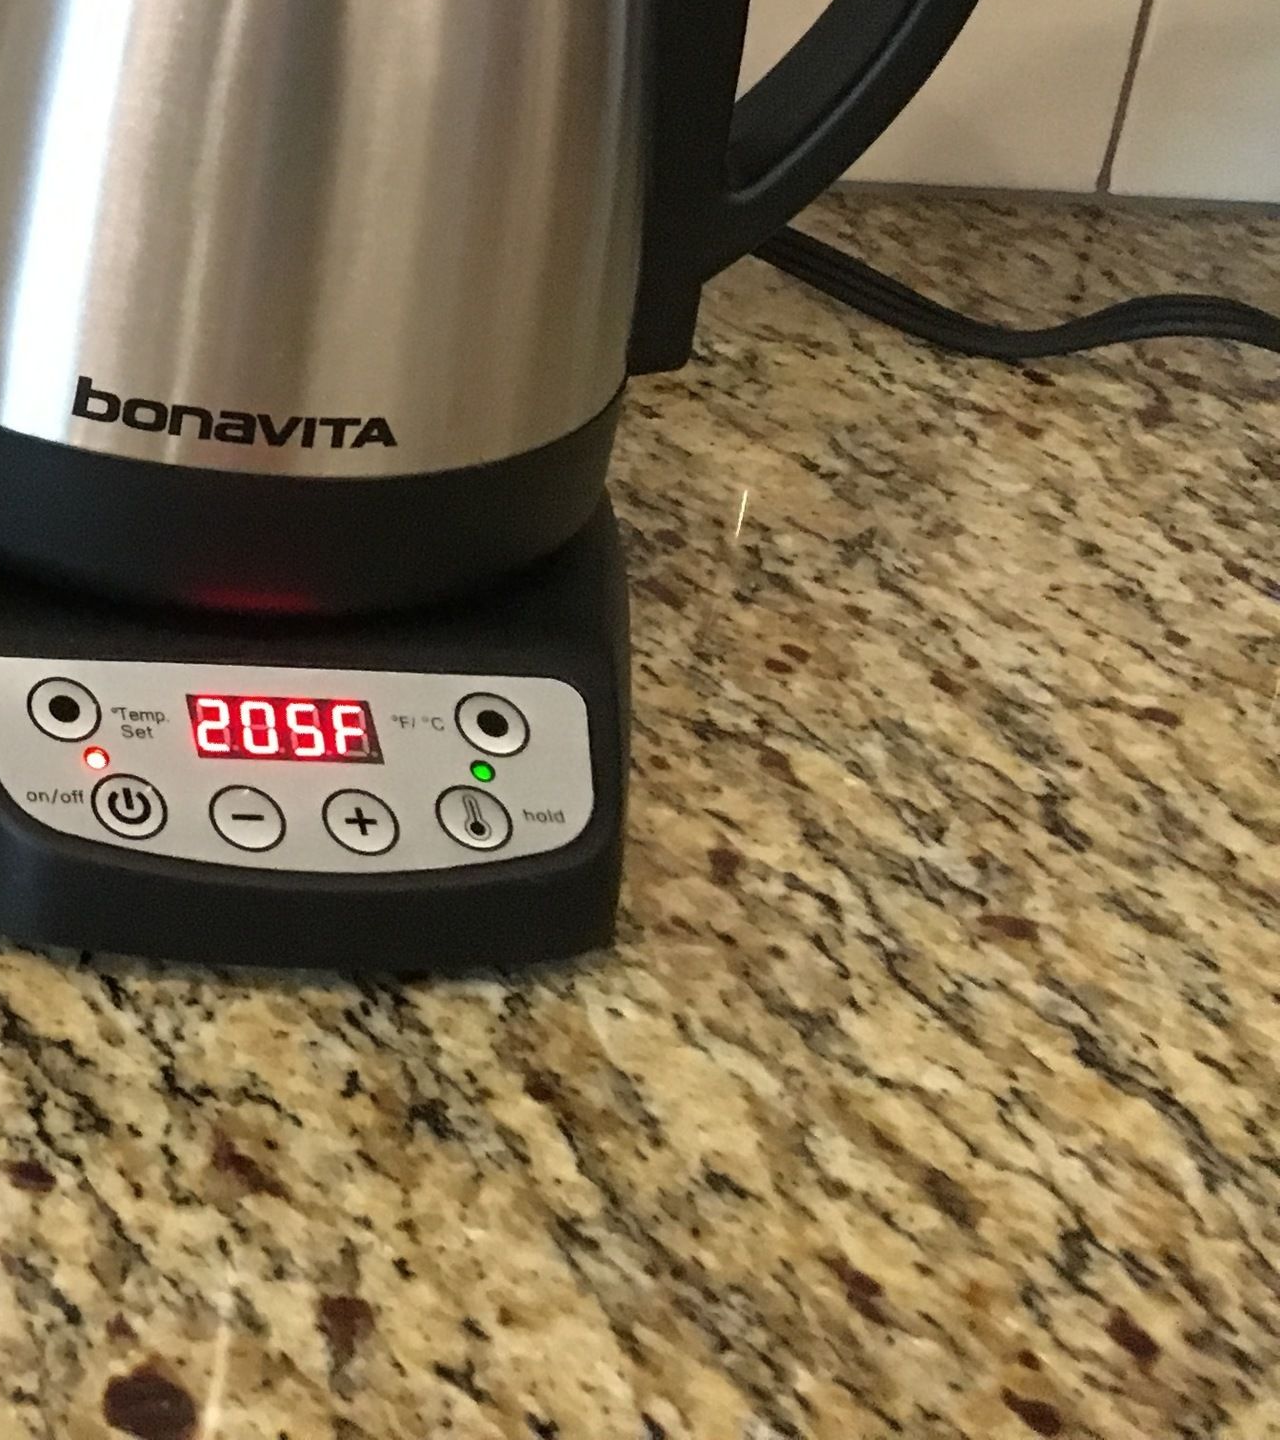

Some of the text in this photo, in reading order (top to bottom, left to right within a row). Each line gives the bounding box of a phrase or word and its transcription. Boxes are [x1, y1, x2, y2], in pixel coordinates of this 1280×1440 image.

[121, 725, 153, 739] Set
[196, 697, 366, 759] 205F
[27, 789, 84, 803] on/off
[522, 809, 566, 824] hold
